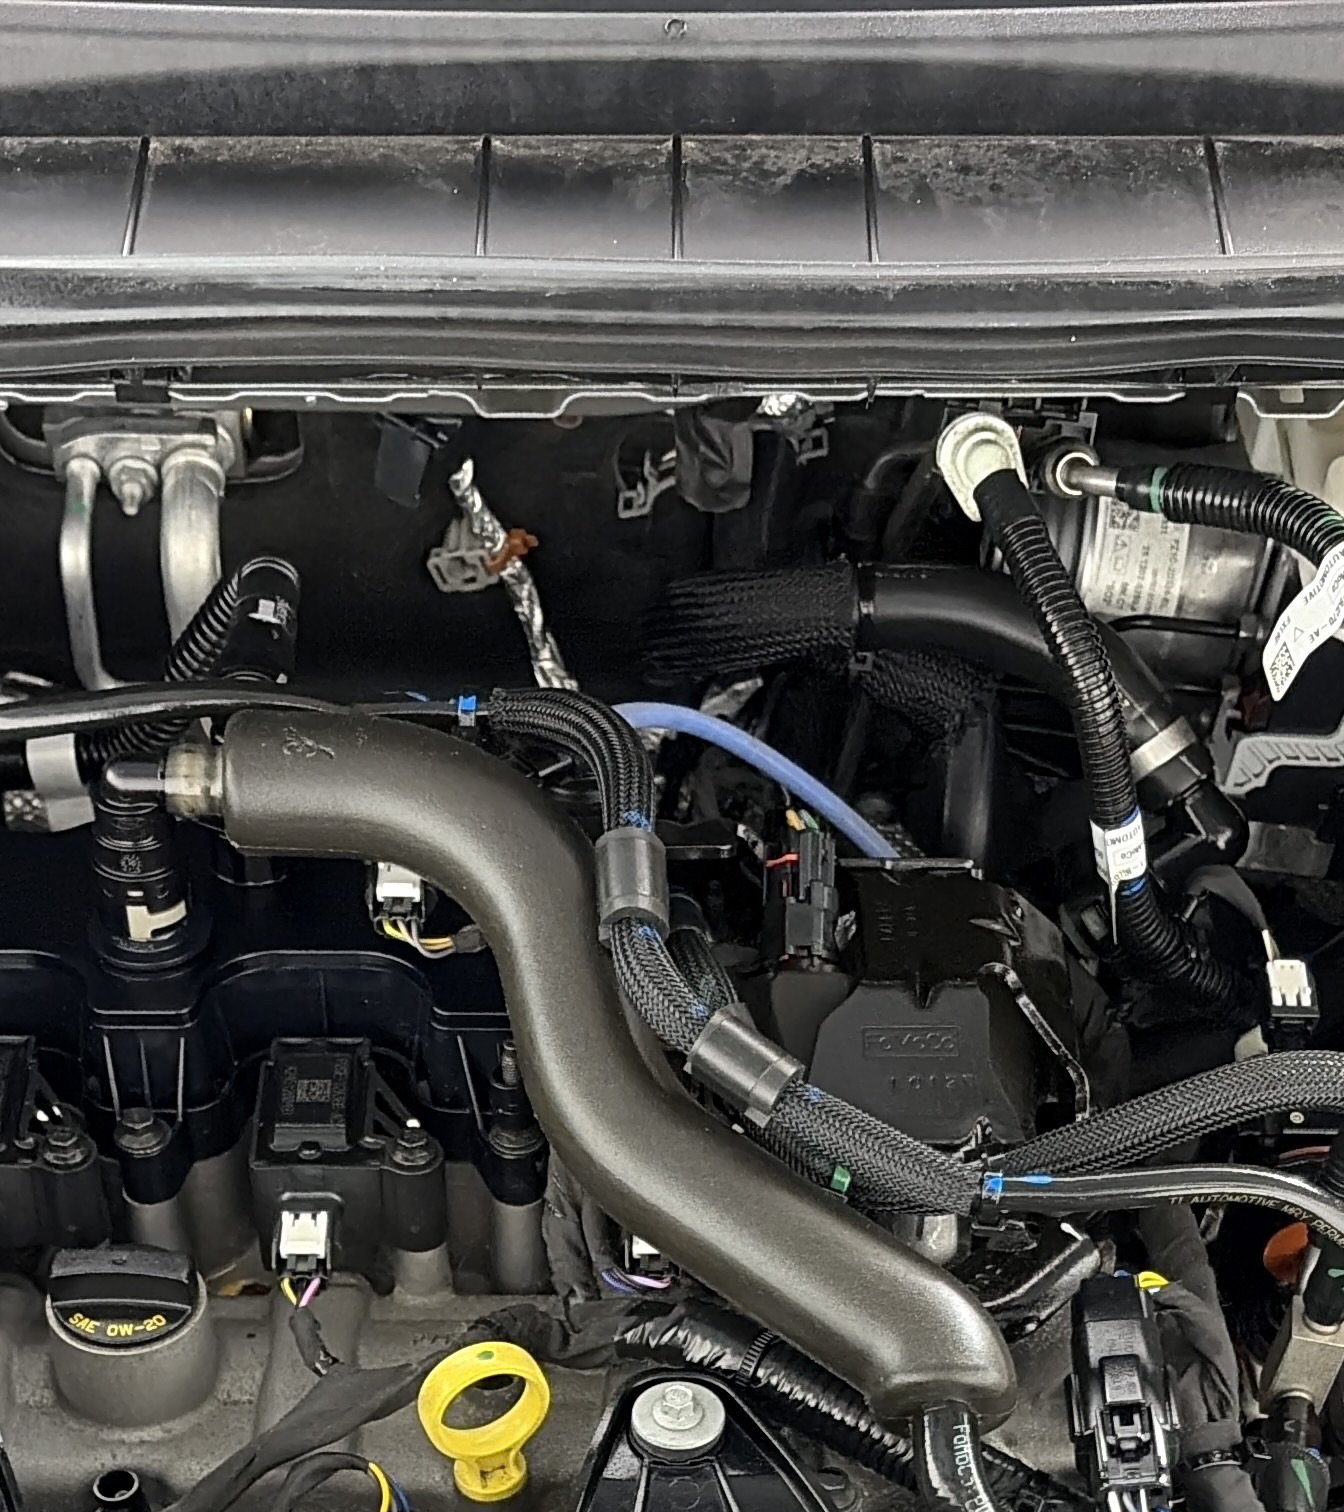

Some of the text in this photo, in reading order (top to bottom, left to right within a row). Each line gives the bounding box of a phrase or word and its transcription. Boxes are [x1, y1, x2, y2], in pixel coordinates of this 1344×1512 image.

[1192, 1195, 1279, 1209] AUTOMOTIVE
[68, 1312, 167, 1336] SAE 0W-20
